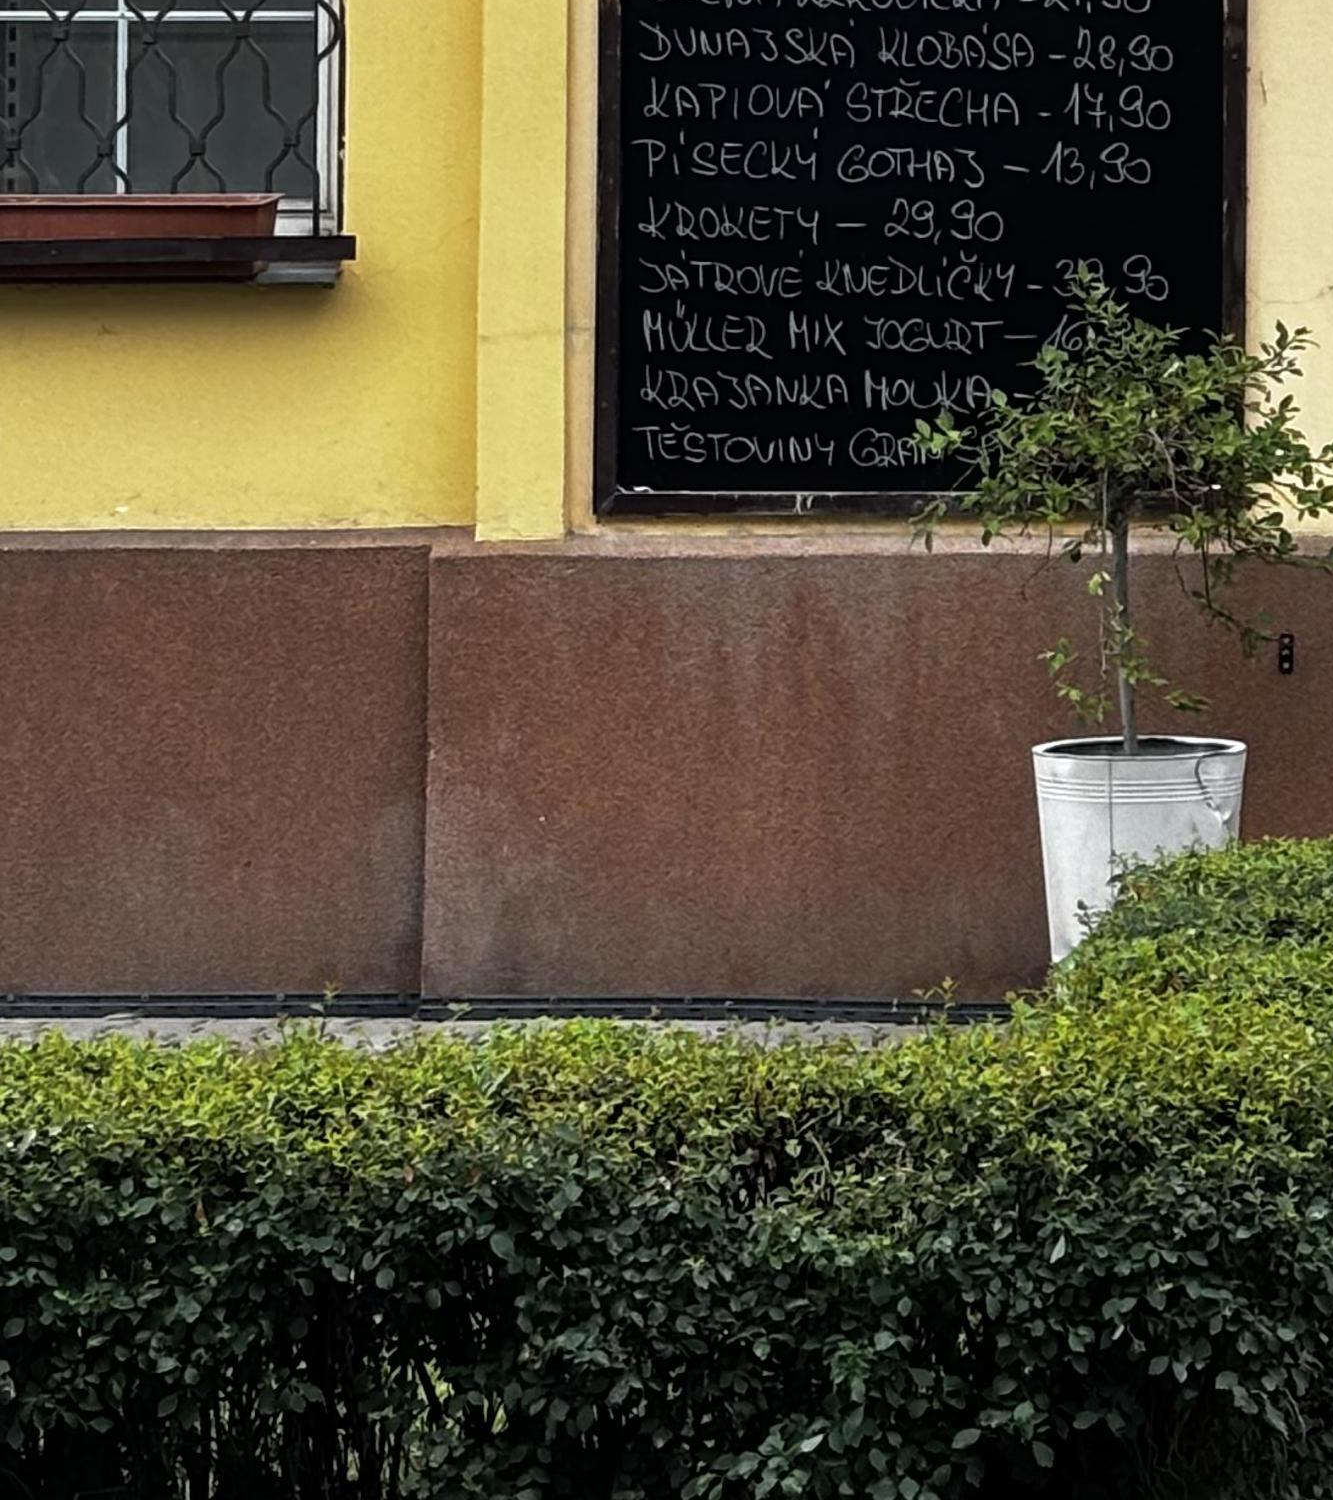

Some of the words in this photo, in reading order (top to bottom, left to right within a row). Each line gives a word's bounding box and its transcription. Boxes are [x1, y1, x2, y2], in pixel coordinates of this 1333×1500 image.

[639, 18, 856, 69] DUNAJSKÁ
[878, 22, 1035, 71] KLOBÁSA
[846, 78, 1020, 128] STŘECHA
[630, 126, 818, 181] PÍSECKÝ
[836, 144, 985, 187] GOTHAJ
[638, 196, 819, 244] KROKETY
[639, 250, 804, 298] JÁTROVÉ
[815, 249, 1016, 301] KNEDLÍČKY
[643, 299, 773, 360] MÜLLER
[789, 310, 847, 356] MIX
[864, 315, 1004, 355] JOGURT
[640, 364, 849, 411] KRAJANKA
[864, 369, 992, 413] MOUKA
[632, 421, 835, 467] TĚSTOVINY
